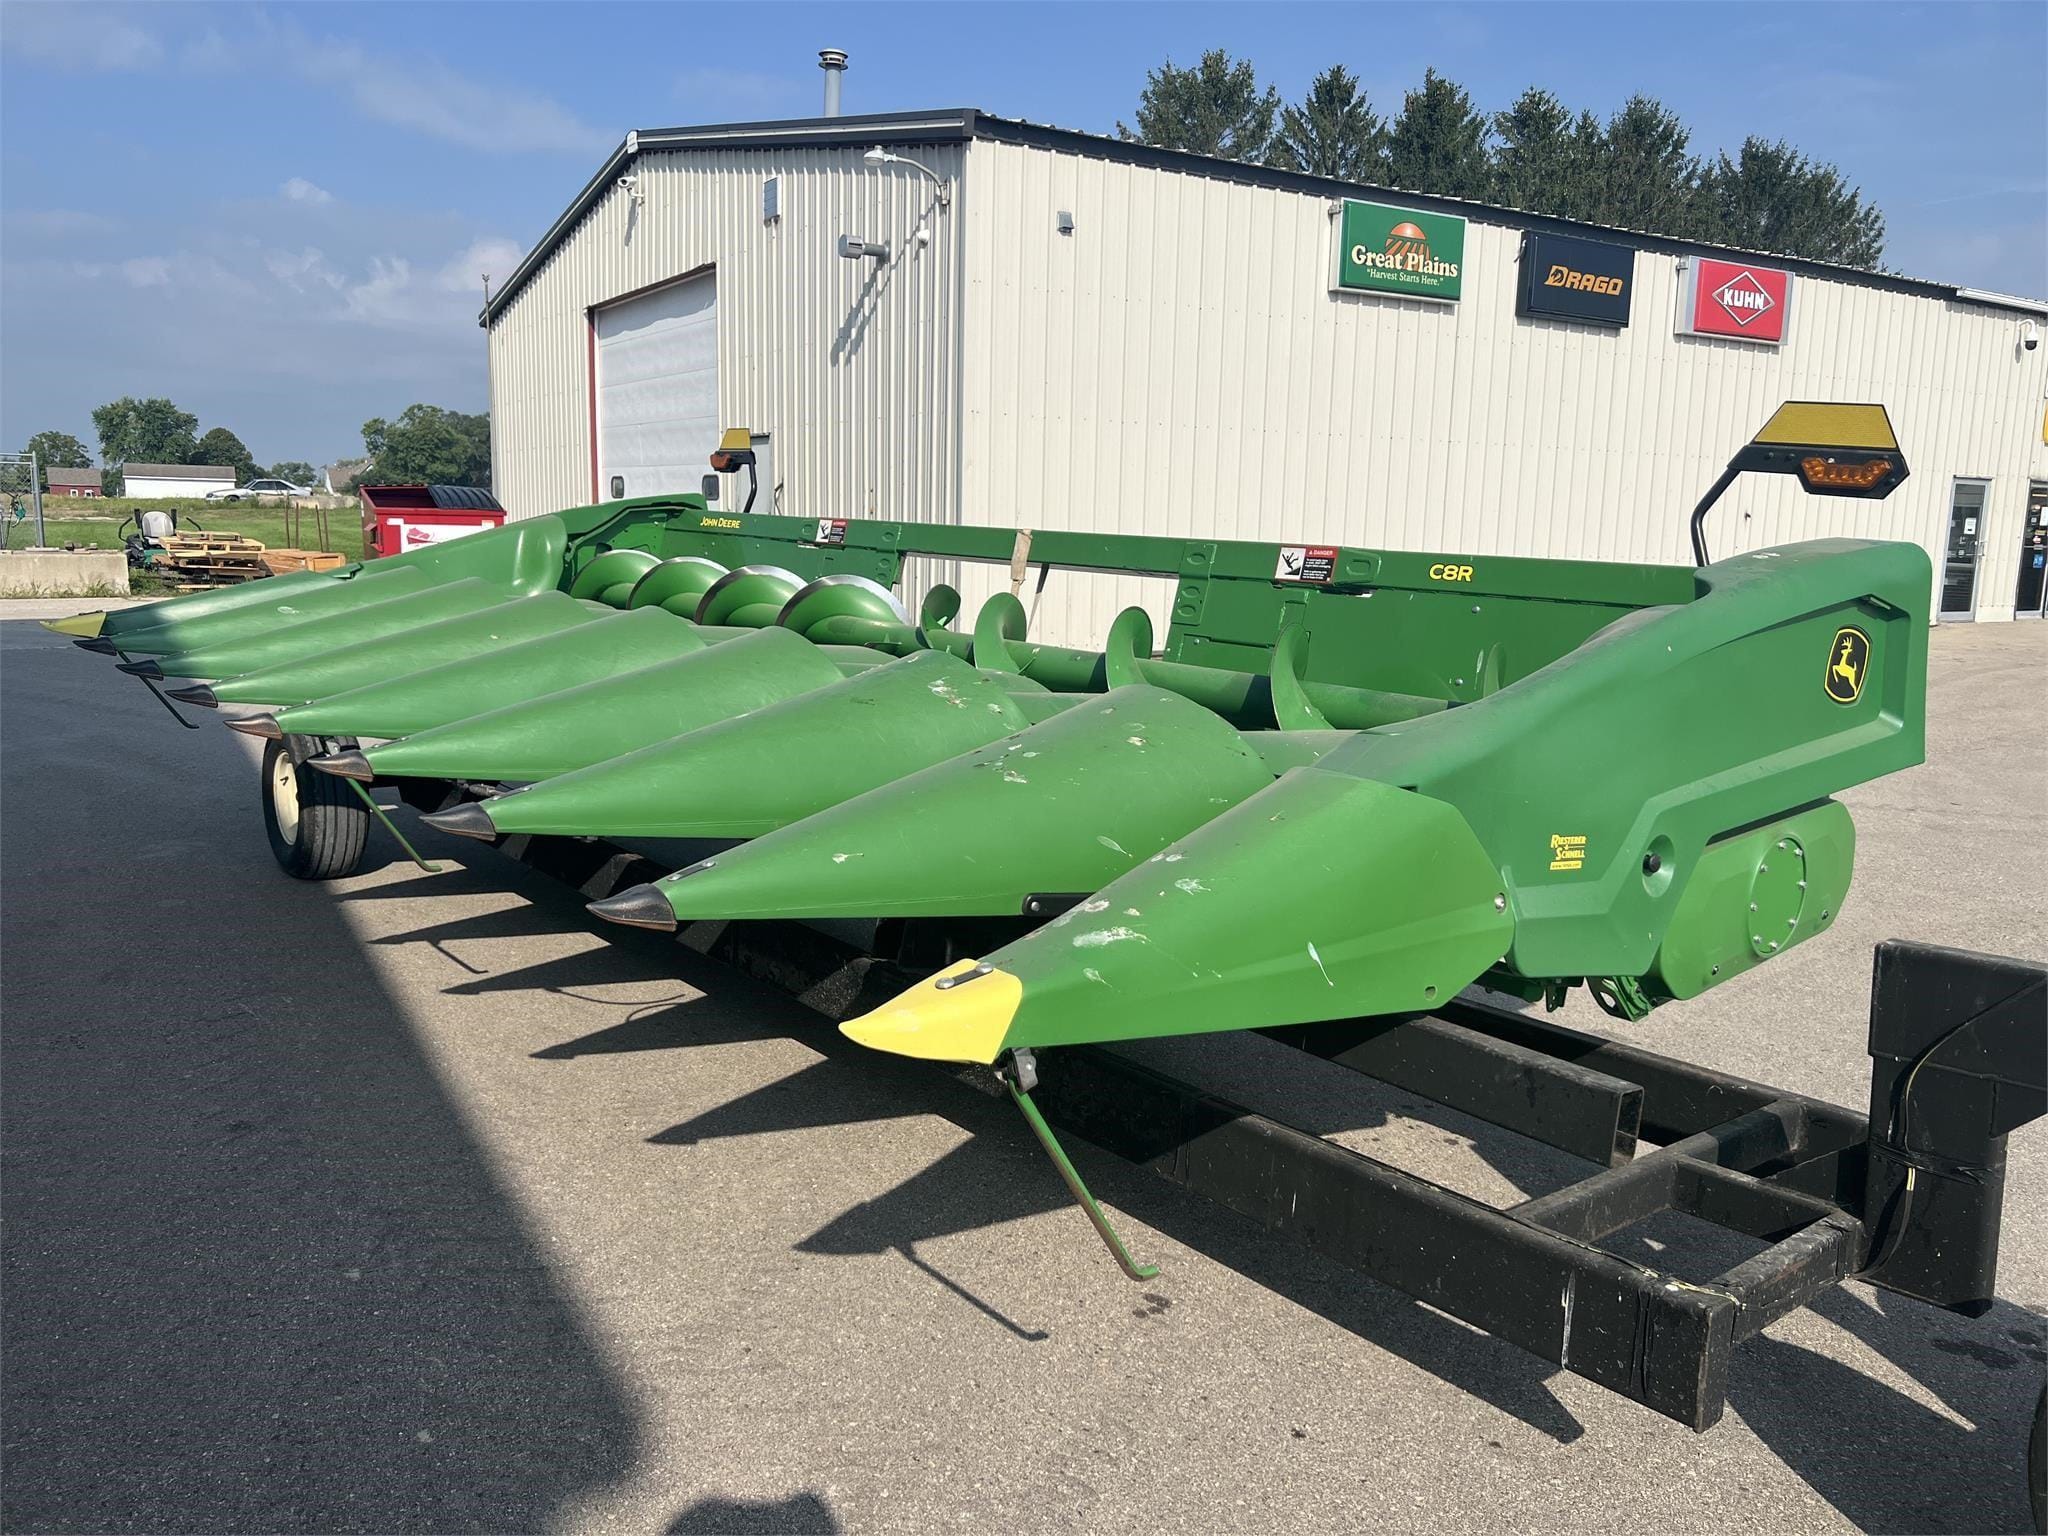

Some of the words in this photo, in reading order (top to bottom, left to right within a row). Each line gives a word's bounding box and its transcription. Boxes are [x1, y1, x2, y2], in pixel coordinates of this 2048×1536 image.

[1351, 245, 1403, 270] Great
[1406, 252, 1458, 278] Plains
[1399, 271, 1420, 284] Starts
[1544, 265, 1624, 296] DRAGO
[1723, 288, 1765, 310] KUHN
[700, 516, 717, 527] JOHN
[718, 517, 741, 529] DEERE
[1429, 563, 1474, 582] C8R
